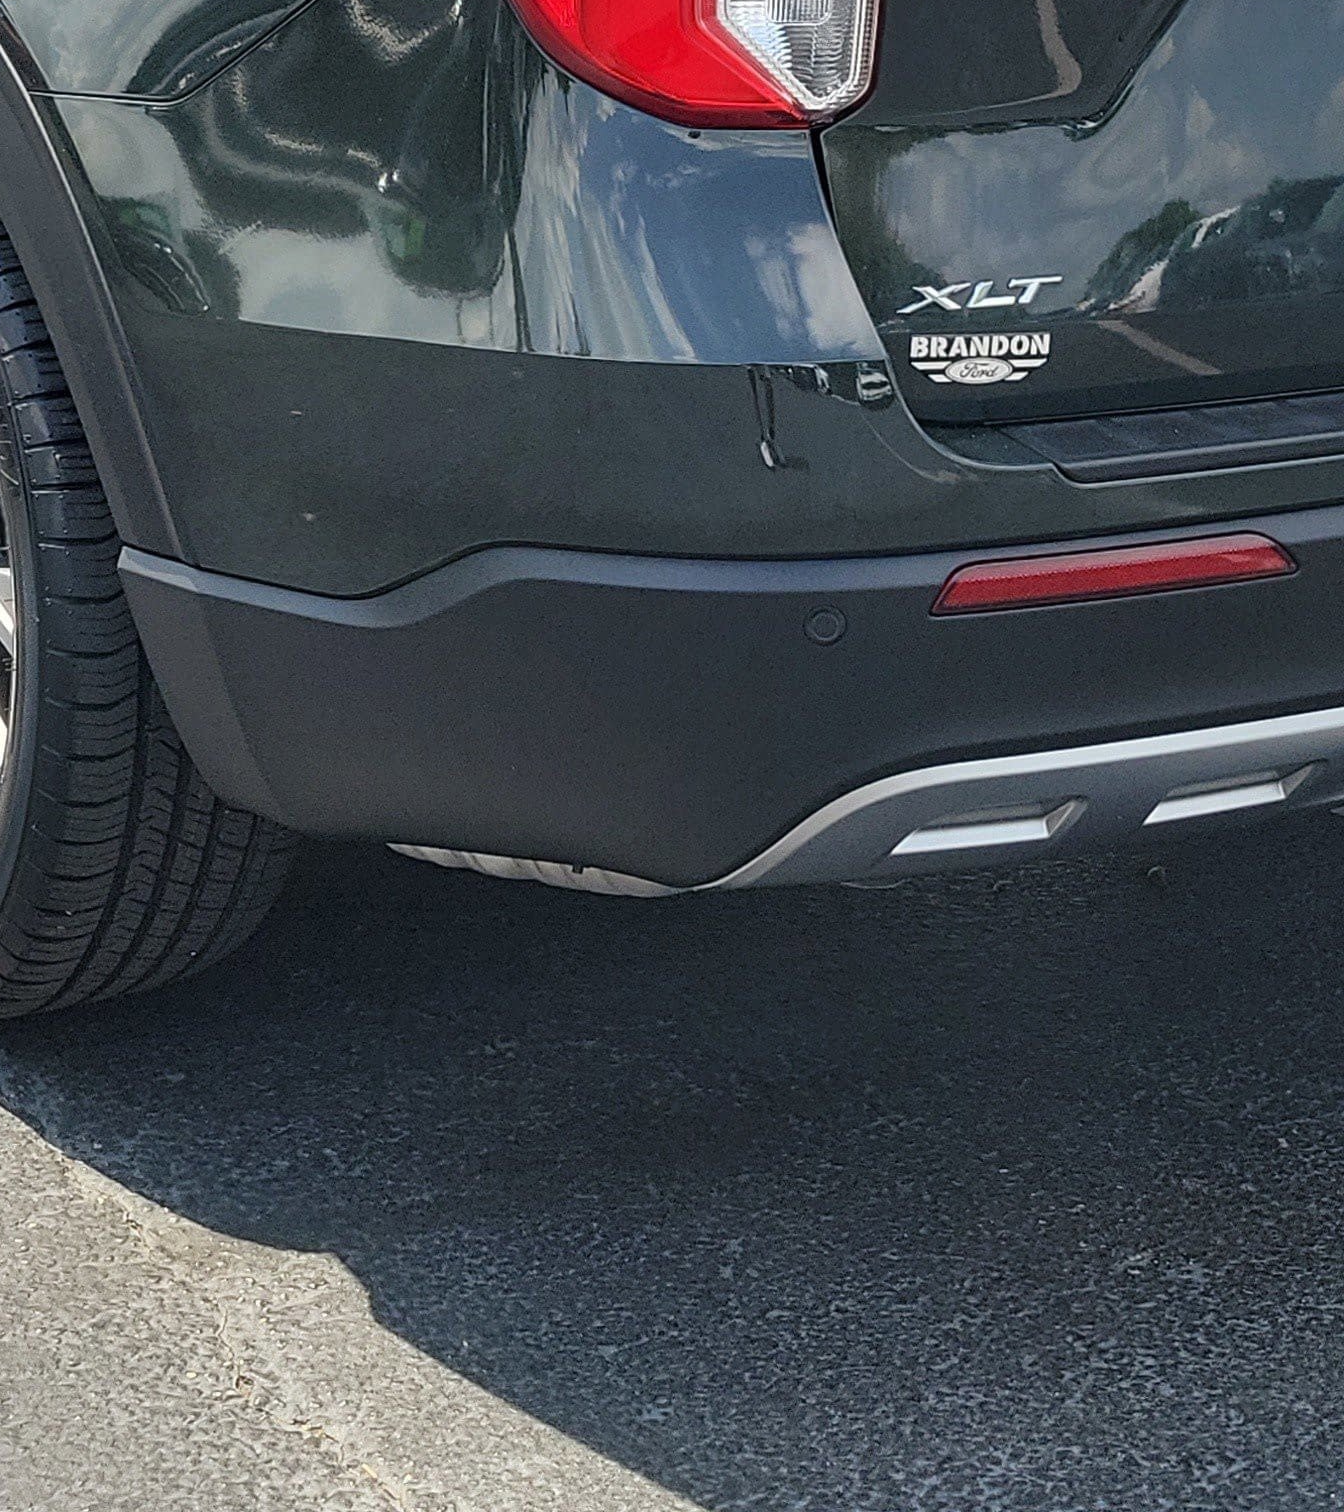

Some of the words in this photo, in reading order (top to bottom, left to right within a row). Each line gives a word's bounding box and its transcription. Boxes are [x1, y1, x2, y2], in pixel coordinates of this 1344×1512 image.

[896, 275, 1063, 314] XLT
[910, 333, 1051, 359] BRANDON
[959, 362, 998, 379] Ford
